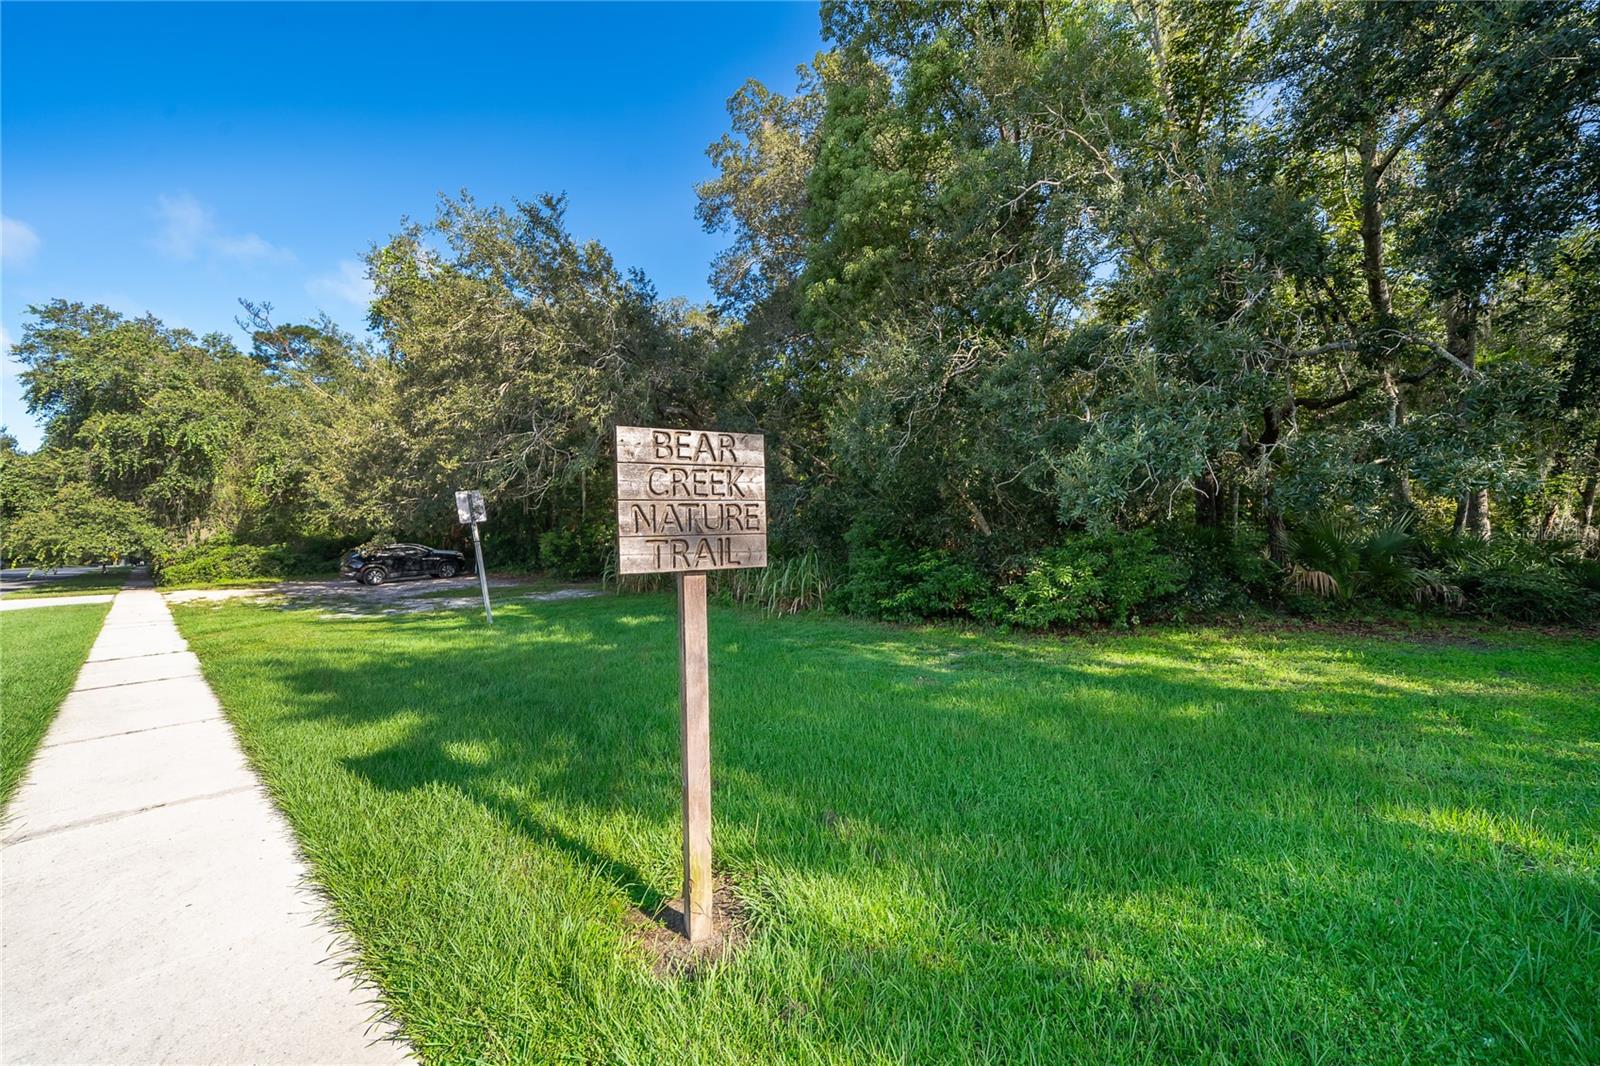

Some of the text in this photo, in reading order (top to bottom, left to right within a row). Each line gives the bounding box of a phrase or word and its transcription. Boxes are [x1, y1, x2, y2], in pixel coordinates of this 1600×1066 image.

[652, 430, 738, 463] BEAR
[648, 467, 746, 498] CREEK
[631, 503, 760, 534] NATURE
[645, 537, 741, 569] TRAIL
